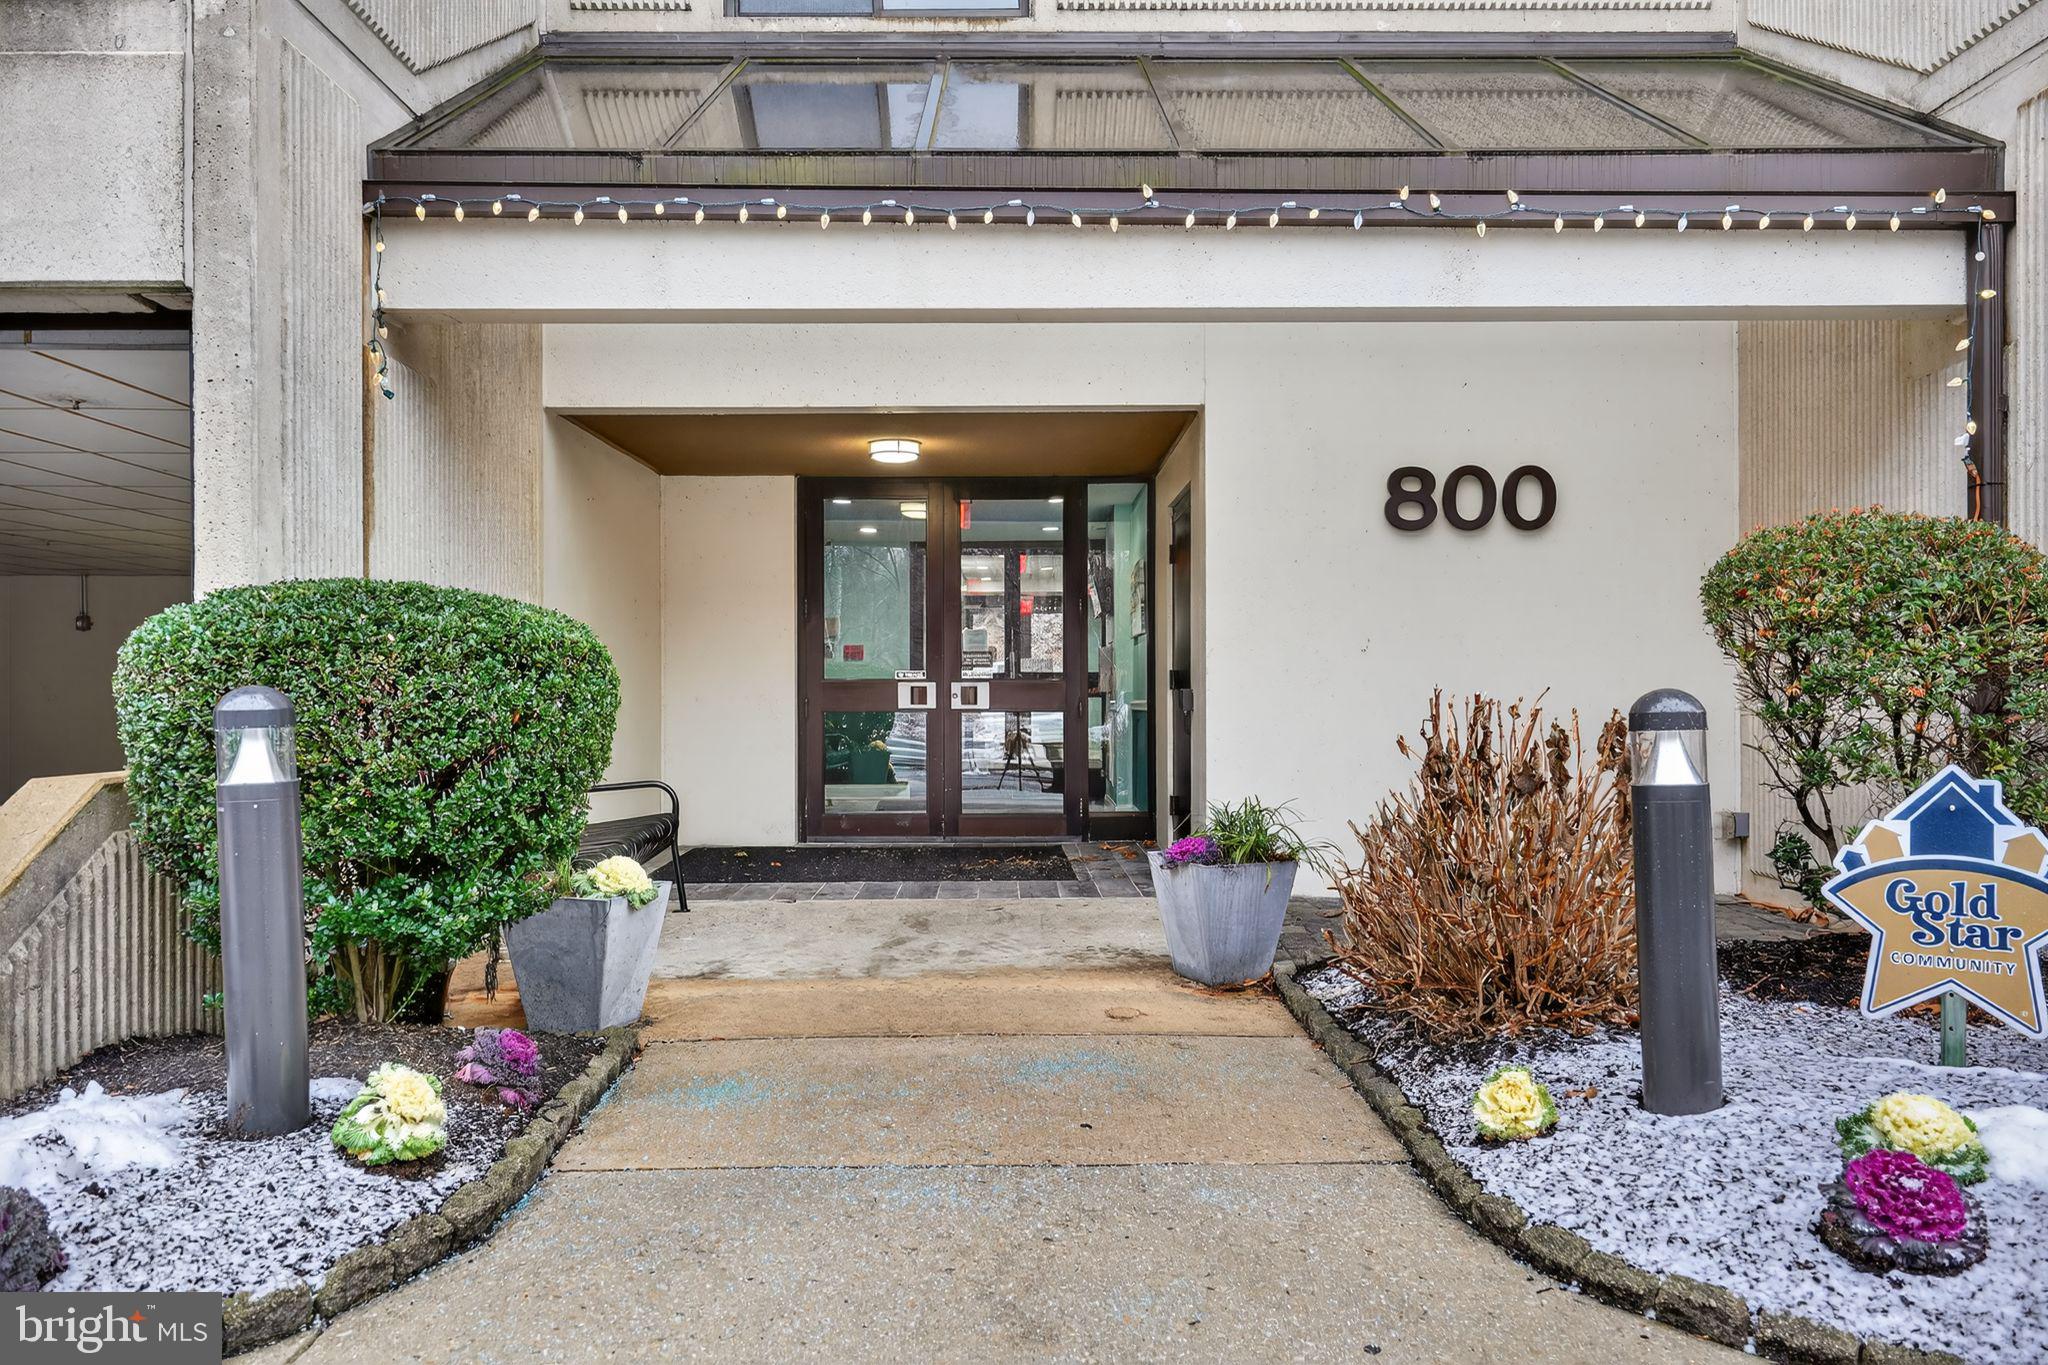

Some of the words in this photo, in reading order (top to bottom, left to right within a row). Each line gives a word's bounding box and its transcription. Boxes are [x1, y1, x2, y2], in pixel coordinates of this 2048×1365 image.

[1384, 465, 1557, 531] 800
[1886, 878, 2000, 920] Gold
[1912, 911, 2022, 951] Star
[1891, 952, 2016, 975] COMMUNITY
